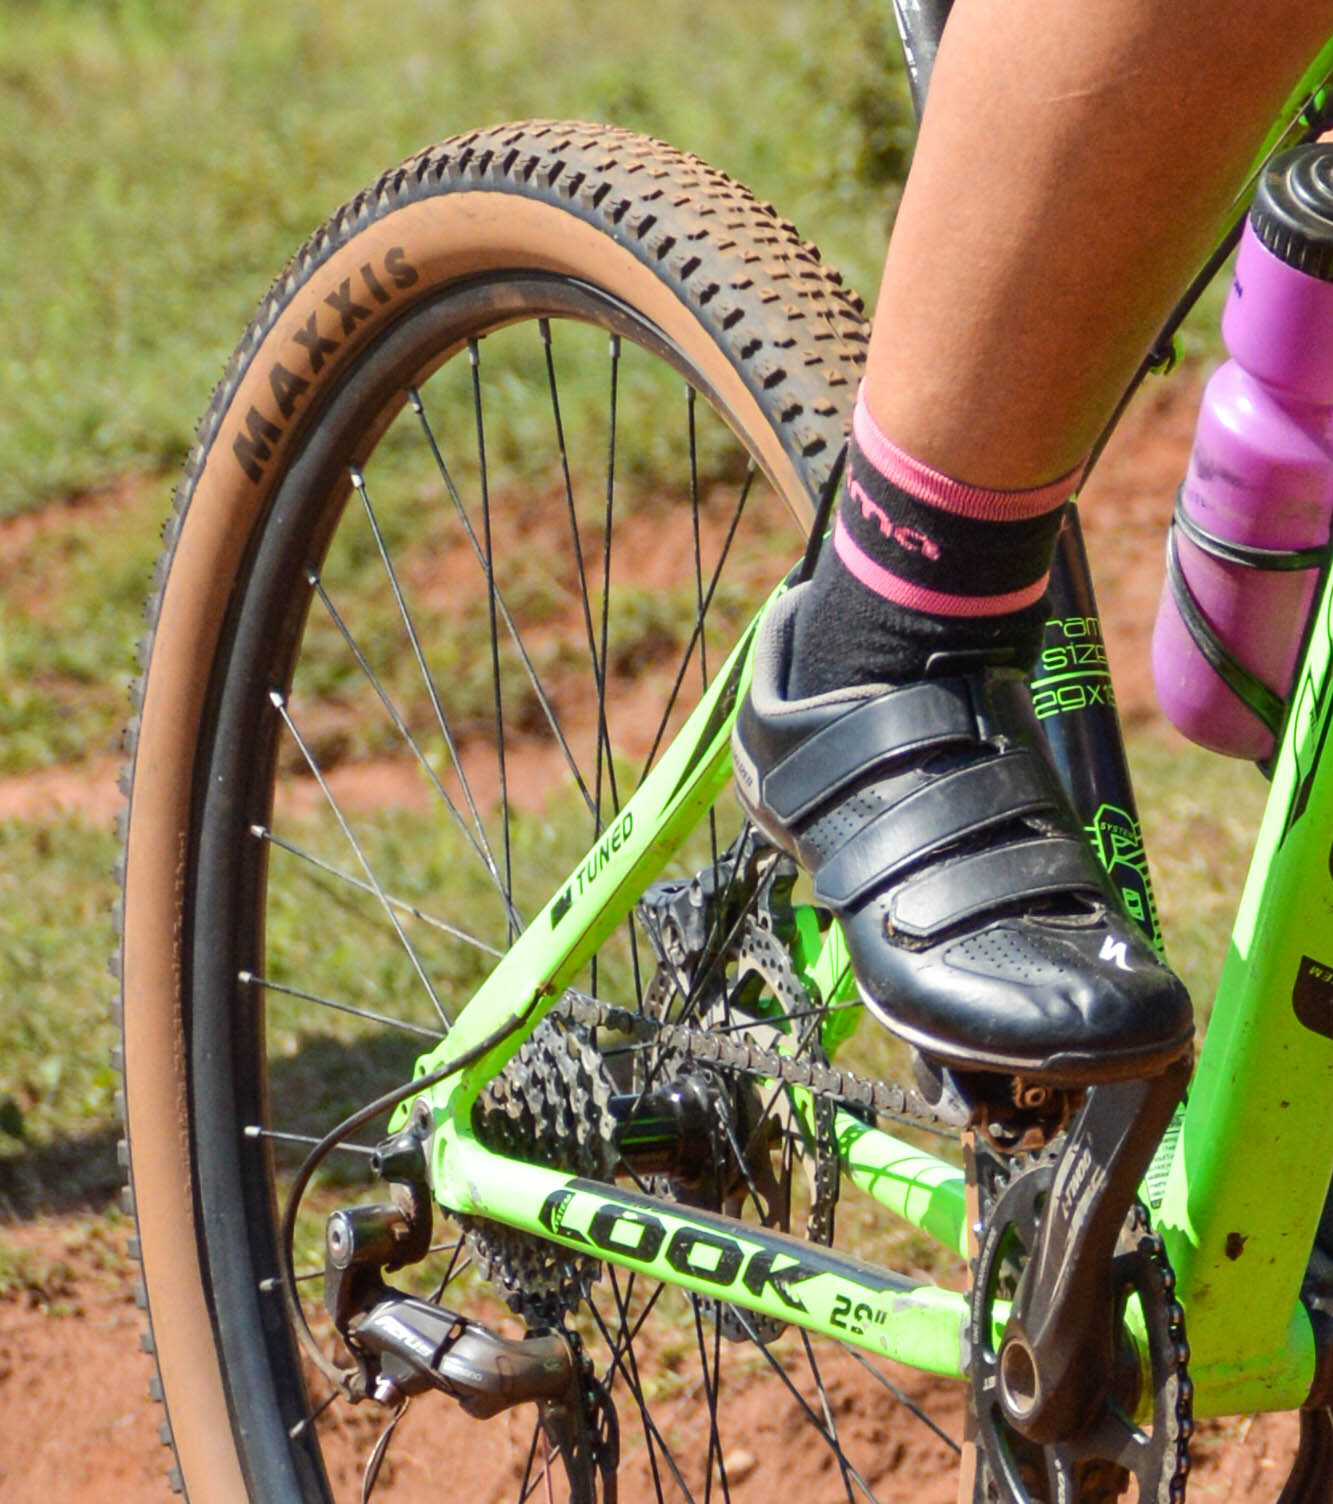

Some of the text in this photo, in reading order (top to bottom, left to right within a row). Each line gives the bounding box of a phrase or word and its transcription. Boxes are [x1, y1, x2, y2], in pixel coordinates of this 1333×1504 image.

[231, 245, 421, 485] MAXXIS
[576, 811, 634, 895] TUNED
[538, 1189, 809, 1314] LOOK
